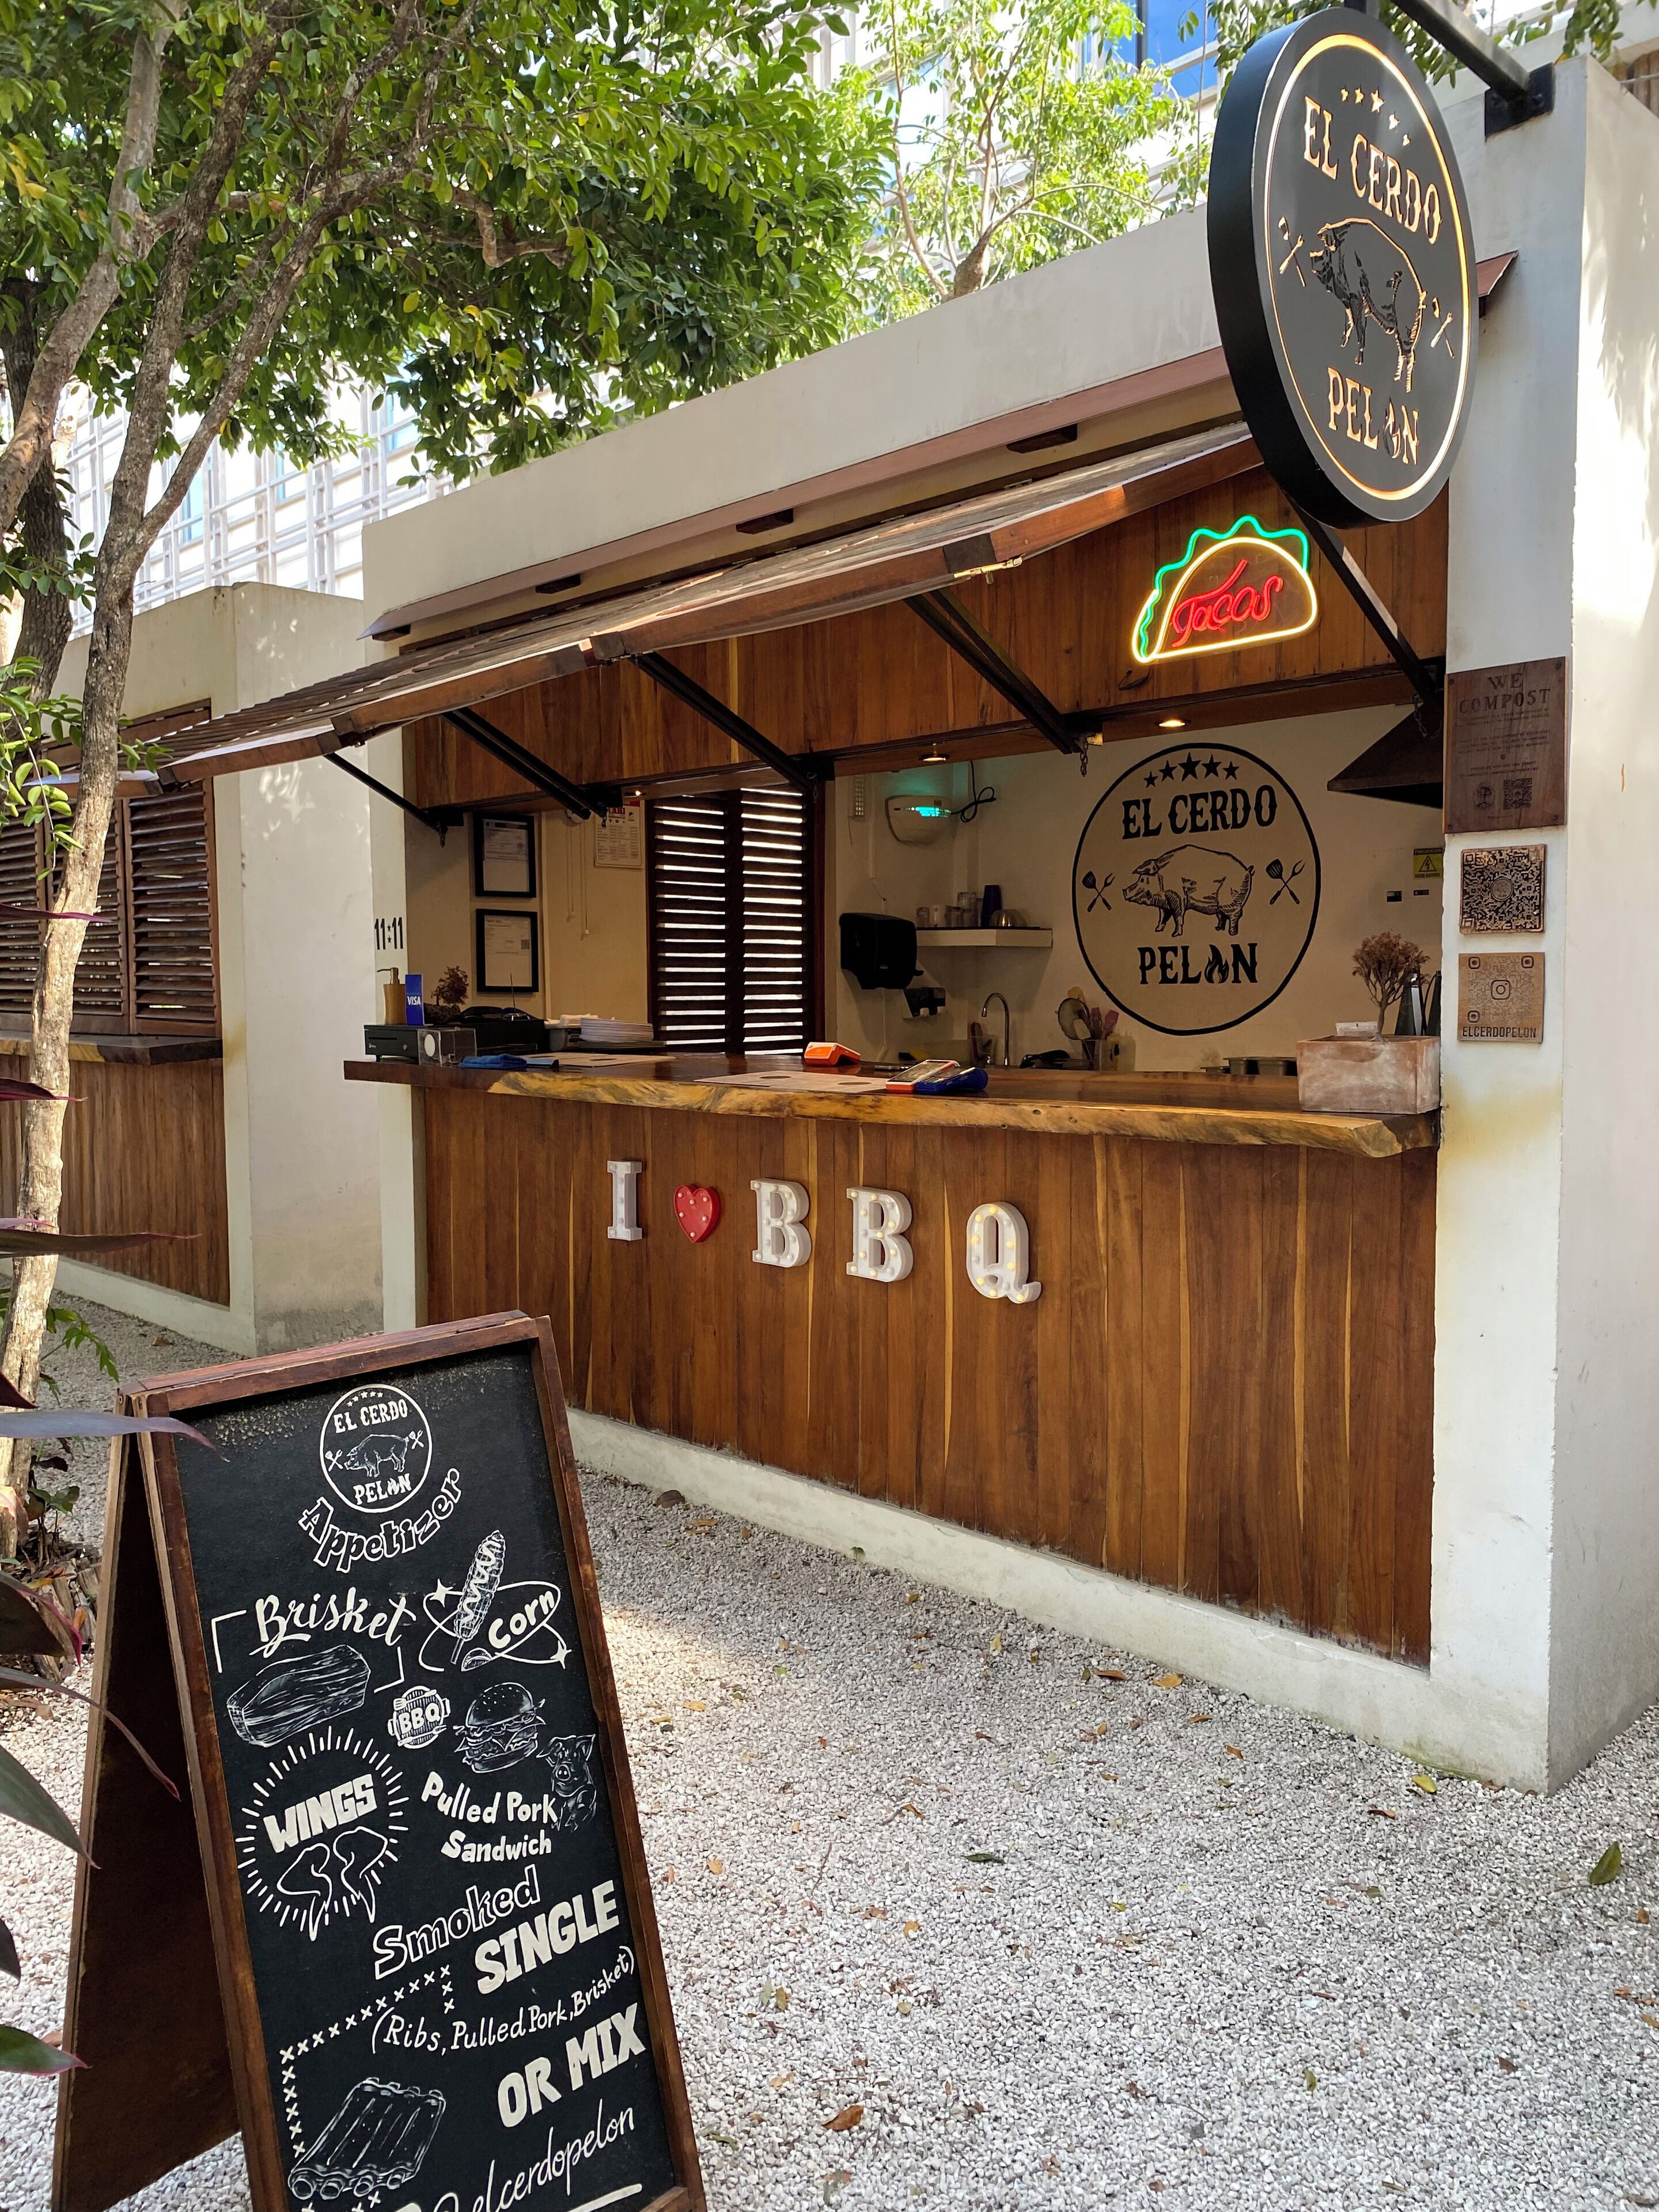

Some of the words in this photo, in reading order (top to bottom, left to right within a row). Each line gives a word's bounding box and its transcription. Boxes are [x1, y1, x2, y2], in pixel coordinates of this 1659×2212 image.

[1304, 96, 1339, 180] EL
[1350, 133, 1442, 245] CERDO
[1172, 558, 1283, 648] Tacos
[1459, 689, 1551, 714] COMPOST
[1487, 673, 1524, 690] WE
[1121, 798, 1162, 840] EL
[1167, 785, 1278, 835] CERDO
[407, 996, 421, 1006] VISA
[1462, 1026, 1536, 1039] ELCERDOPELON
[607, 1160, 643, 1241] I
[333, 1411, 358, 1434] EL
[359, 1399, 408, 1427] CERDO
[298, 1468, 462, 1574] Appetizer
[249, 1586, 416, 1658] Brisket
[488, 1590, 555, 1649] Corn
[397, 1702, 441, 1734] BBQ
[262, 1774, 377, 1853] WINGS
[421, 1771, 502, 1824] Pulled
[507, 1791, 558, 1824] Pork
[441, 1829, 552, 1863] Sandwich
[372, 1863, 541, 1980] Smoked
[474, 1880, 620, 1995] SINGLE
[372, 2007, 447, 2055] (Ribs,
[450, 2006, 527, 2050] Pulled
[498, 2056, 562, 2128] OR
[565, 2002, 646, 2091] MIX
